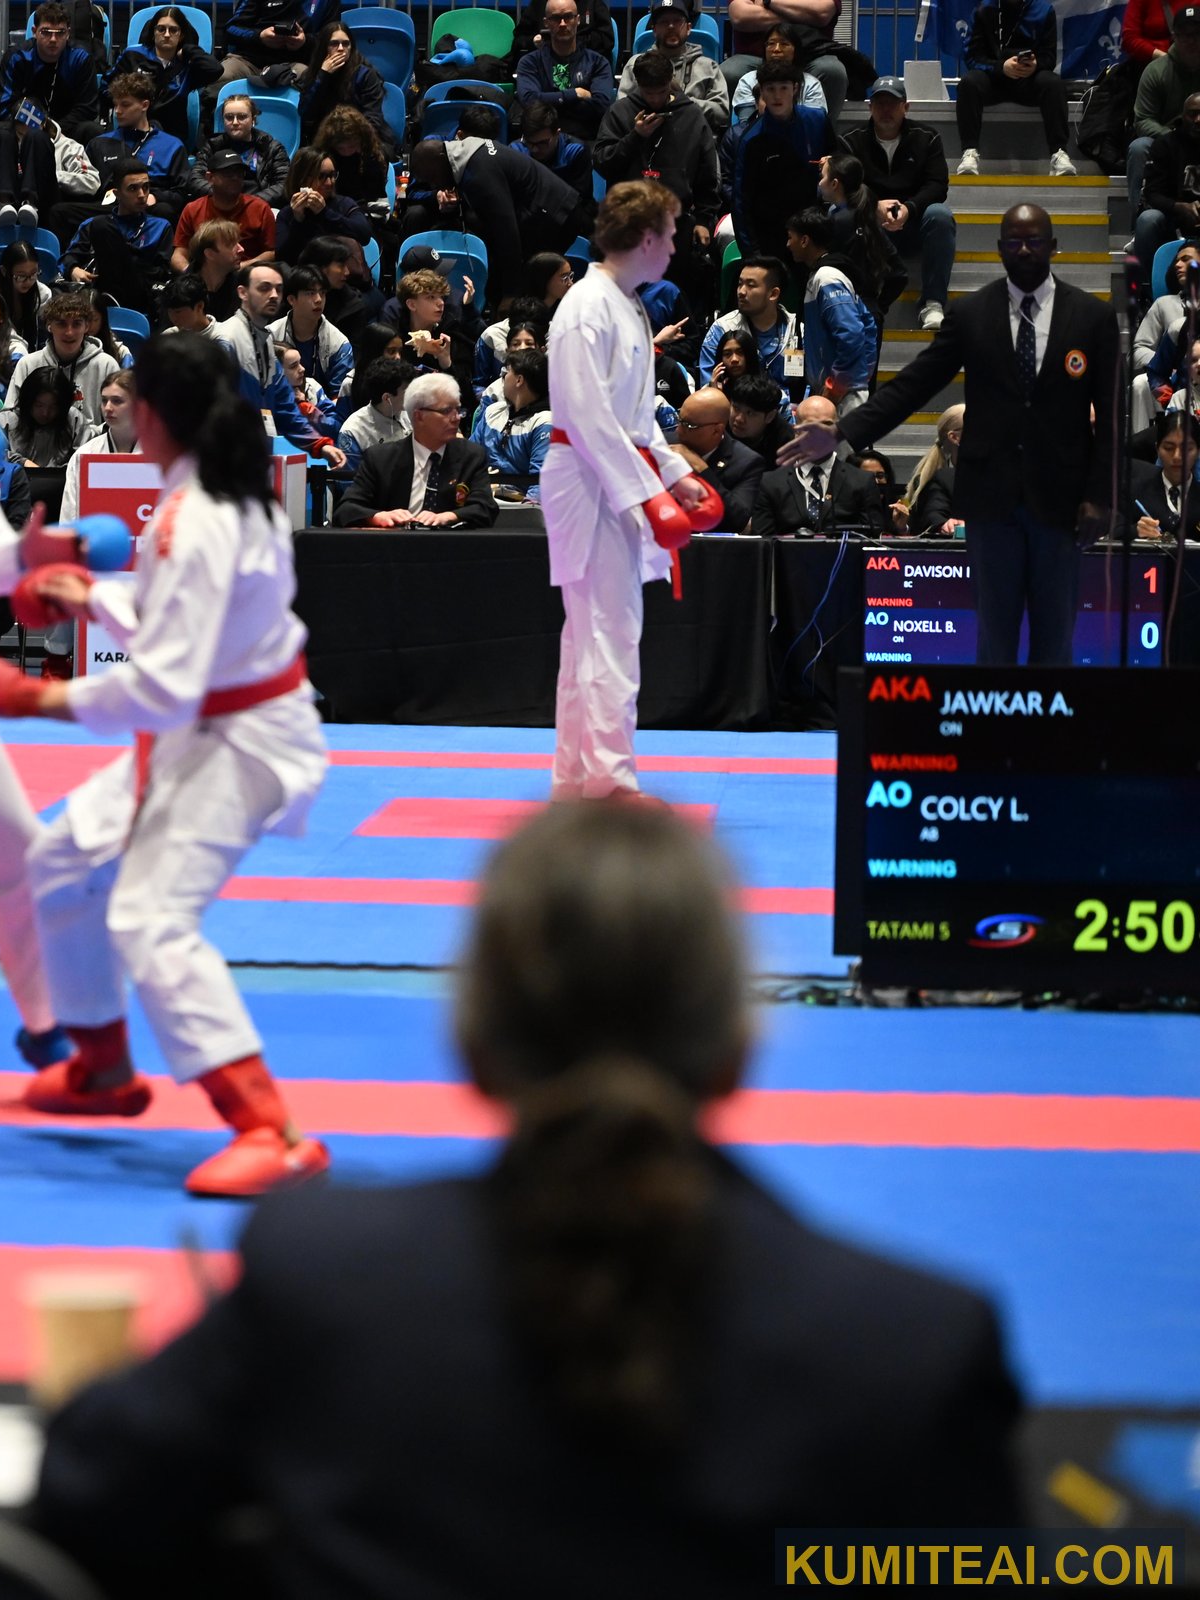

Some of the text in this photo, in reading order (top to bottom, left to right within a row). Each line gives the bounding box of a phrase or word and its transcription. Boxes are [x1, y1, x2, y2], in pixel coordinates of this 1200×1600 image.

[866, 556, 900, 571] AKA
[904, 565, 963, 578] DAVISON
[1143, 566, 1157, 594] 1
[867, 598, 913, 607] WARNING
[865, 611, 889, 625] AO
[893, 619, 957, 634] NOXELL B.
[1141, 622, 1160, 649] 0
[865, 652, 912, 662] WARNING
[868, 675, 932, 701] AKA
[940, 690, 1074, 717] JAWKAR A.
[939, 721, 963, 737] ON
[870, 754, 958, 772] WARNING
[866, 780, 912, 808] AO
[920, 795, 1029, 822] COLCY L.
[867, 859, 957, 878] WARNING
[867, 920, 934, 940] TATAMI
[1073, 899, 1196, 953] 2:50
